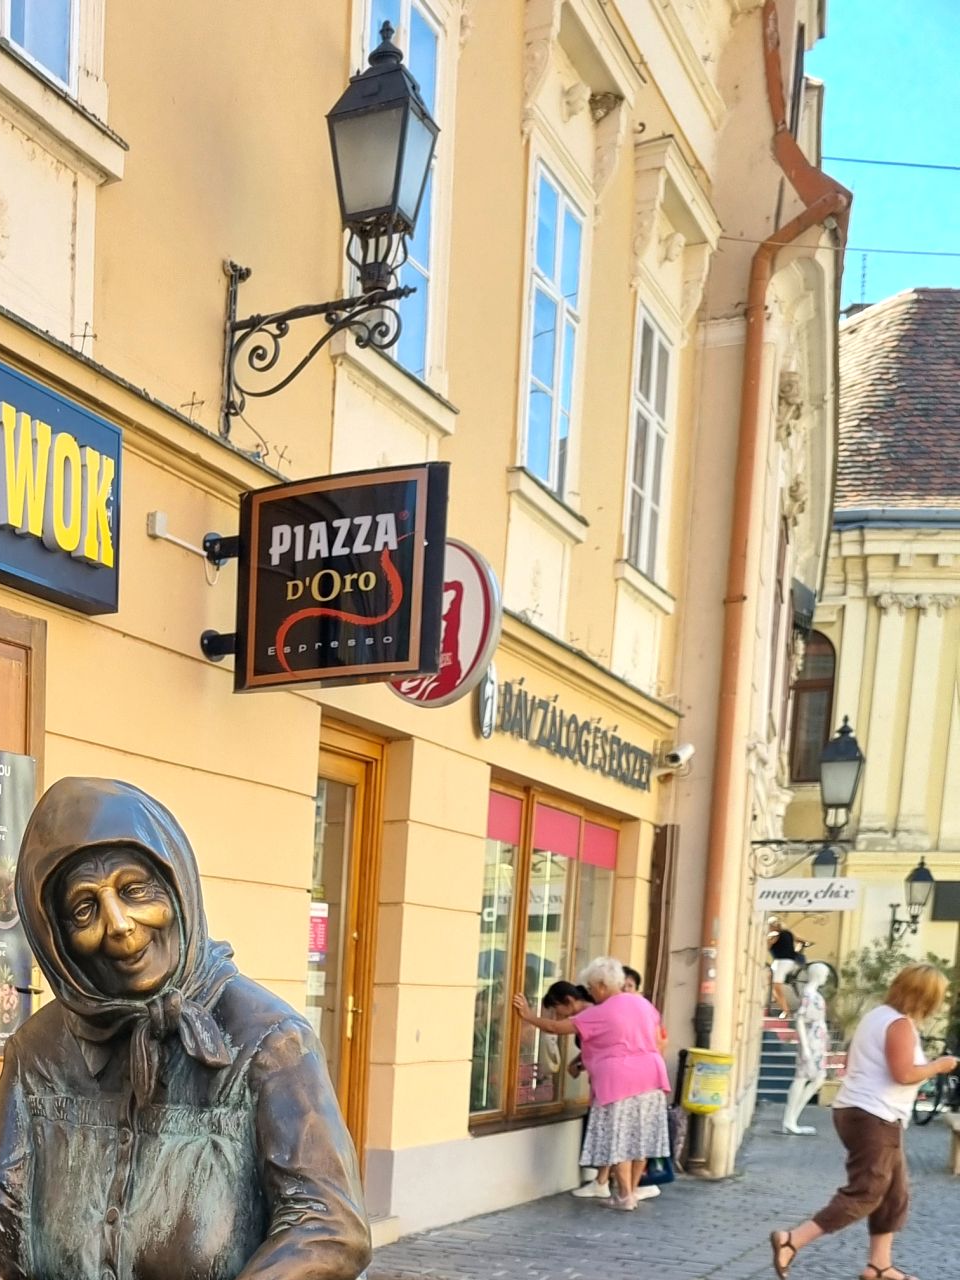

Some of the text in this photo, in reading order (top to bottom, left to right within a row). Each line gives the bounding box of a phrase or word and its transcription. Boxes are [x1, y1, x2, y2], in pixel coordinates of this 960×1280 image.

[269, 513, 398, 566] PIAZZA
[268, 636, 393, 655] Espresso
[758, 890, 810, 905] mayo
